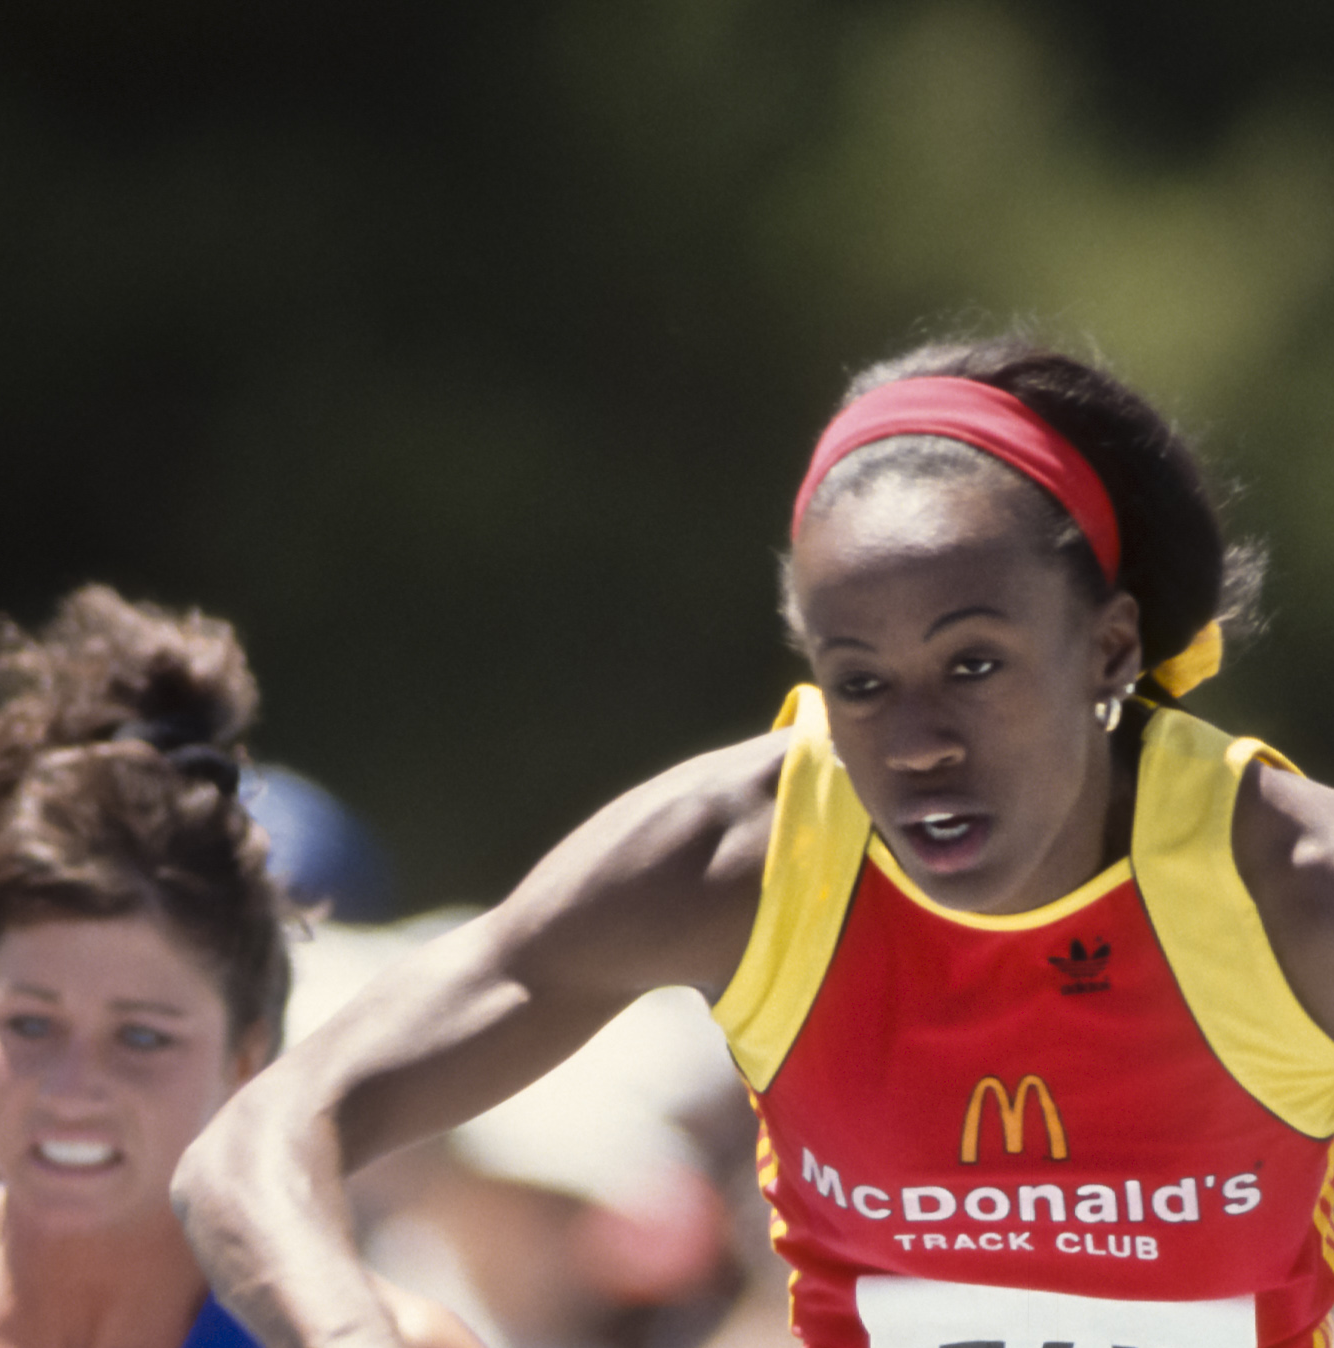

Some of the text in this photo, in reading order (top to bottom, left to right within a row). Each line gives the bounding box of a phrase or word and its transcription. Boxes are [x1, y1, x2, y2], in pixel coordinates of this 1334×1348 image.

[802, 1147, 1263, 1224] McDonald's
[894, 1232, 1159, 1260] TRACK CLUB
